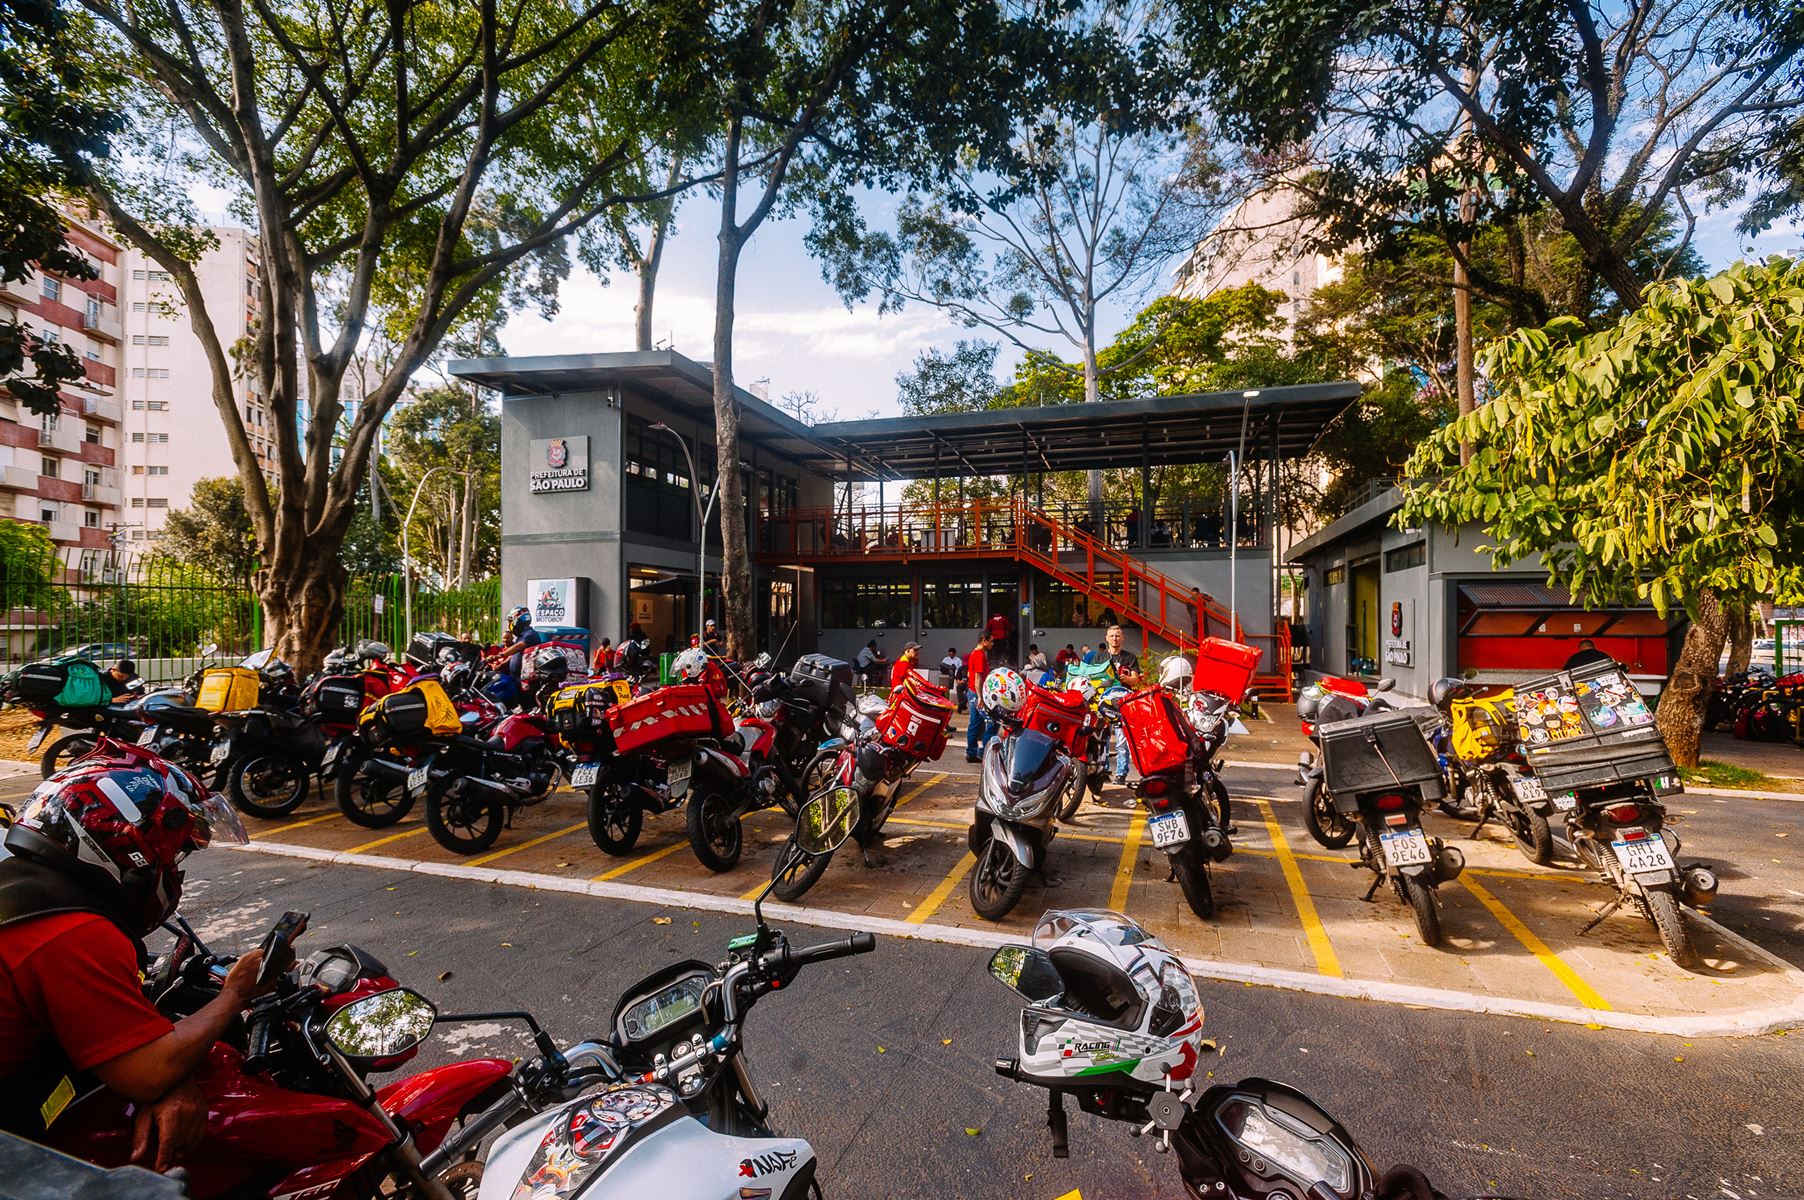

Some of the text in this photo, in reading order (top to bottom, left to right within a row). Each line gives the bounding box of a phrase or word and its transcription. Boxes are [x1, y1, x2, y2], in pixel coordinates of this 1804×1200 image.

[530, 470, 572, 479] PREFEITURA
[551, 478, 585, 489] PAULO
[1158, 819, 1178, 832] SWB
[1157, 828, 1184, 843] 9F76
[1392, 838, 1417, 850] FOS
[1626, 842, 1654, 856] GHI
[1392, 849, 1425, 862] 9E46
[1629, 854, 1666, 869] 4A28
[1074, 1041, 1110, 1053] RACING
